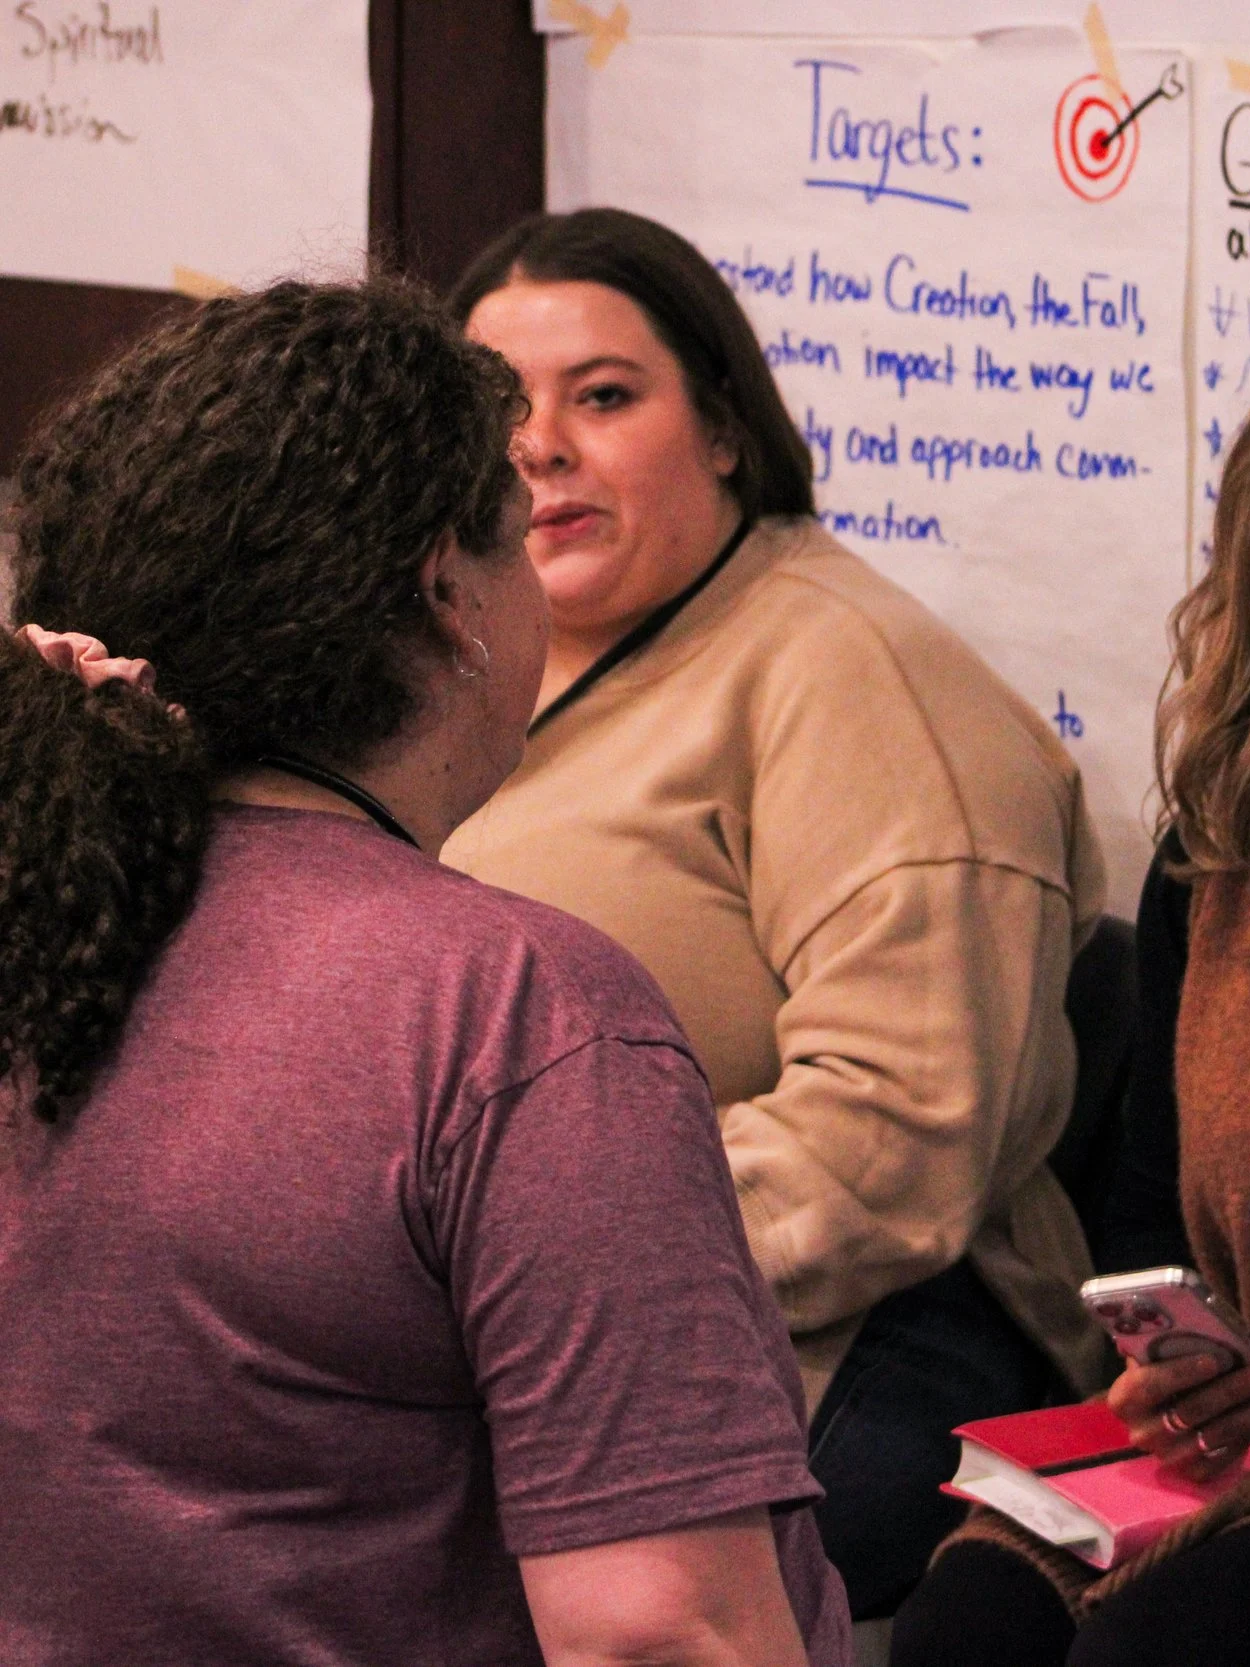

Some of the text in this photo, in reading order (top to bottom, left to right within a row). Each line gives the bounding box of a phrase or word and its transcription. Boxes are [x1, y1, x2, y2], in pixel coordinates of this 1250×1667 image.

[794, 60, 983, 202] Targets:
[809, 248, 871, 303] how
[1024, 270, 1080, 327] the
[1083, 271, 1146, 337] Fall,
[864, 344, 957, 399] impact
[972, 343, 1020, 393] the
[1030, 363, 1094, 419] way
[1110, 360, 1155, 394] we
[845, 422, 898, 468] and
[910, 430, 1042, 483] approach
[1053, 688, 1084, 739] to
